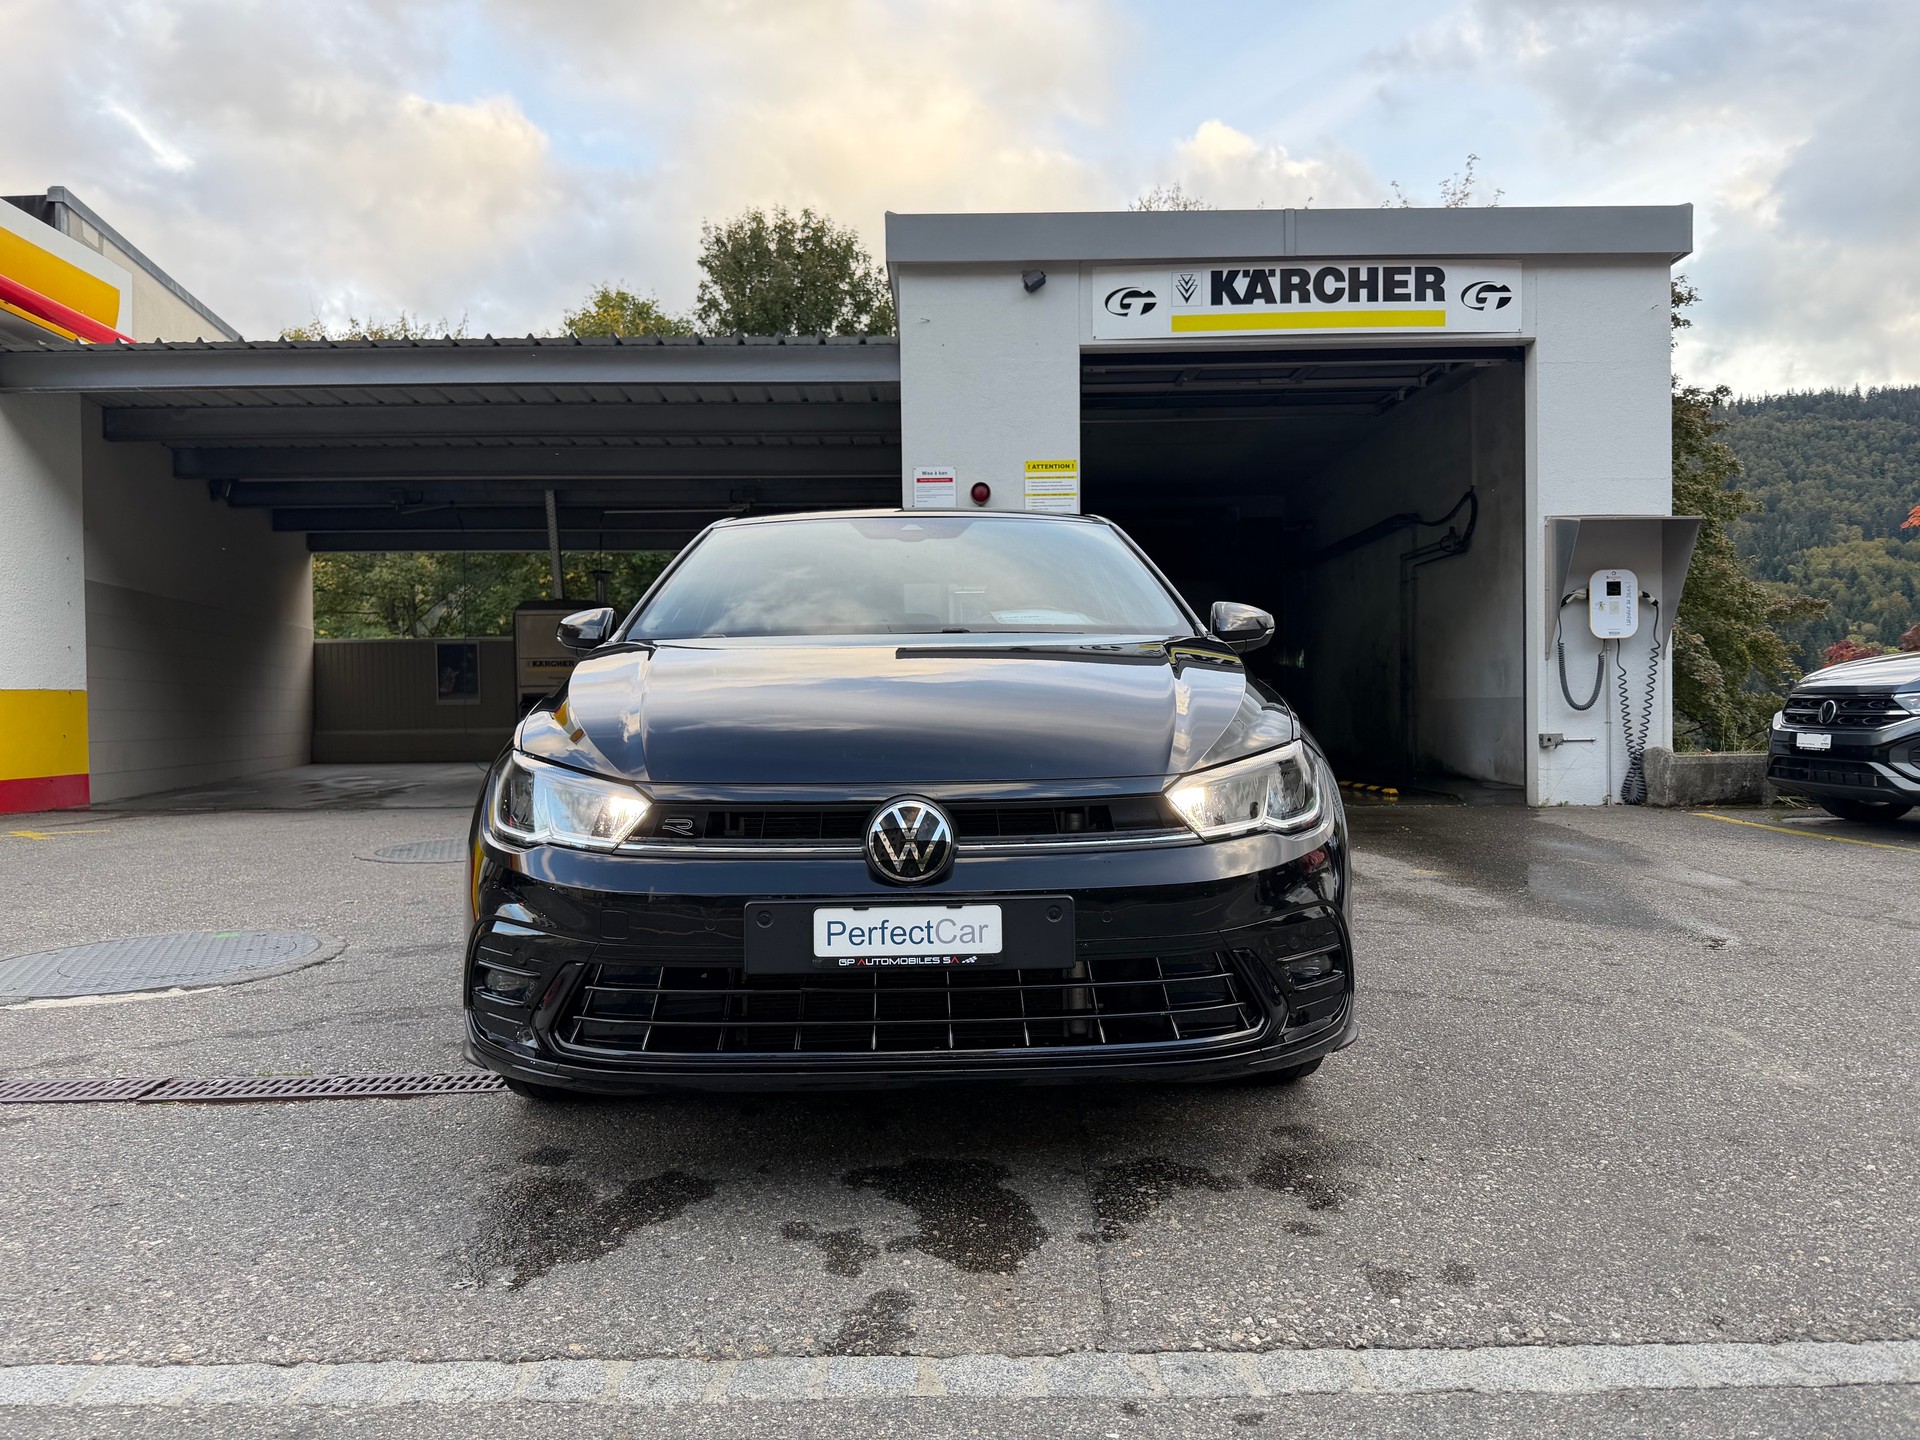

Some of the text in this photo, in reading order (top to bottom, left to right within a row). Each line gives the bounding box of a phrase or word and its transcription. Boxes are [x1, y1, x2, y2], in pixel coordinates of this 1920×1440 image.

[1210, 266, 1446, 306] KÄRCHER
[827, 918, 989, 946] PerfectCar
[838, 956, 960, 967] GP AUTOMOBILES SA
